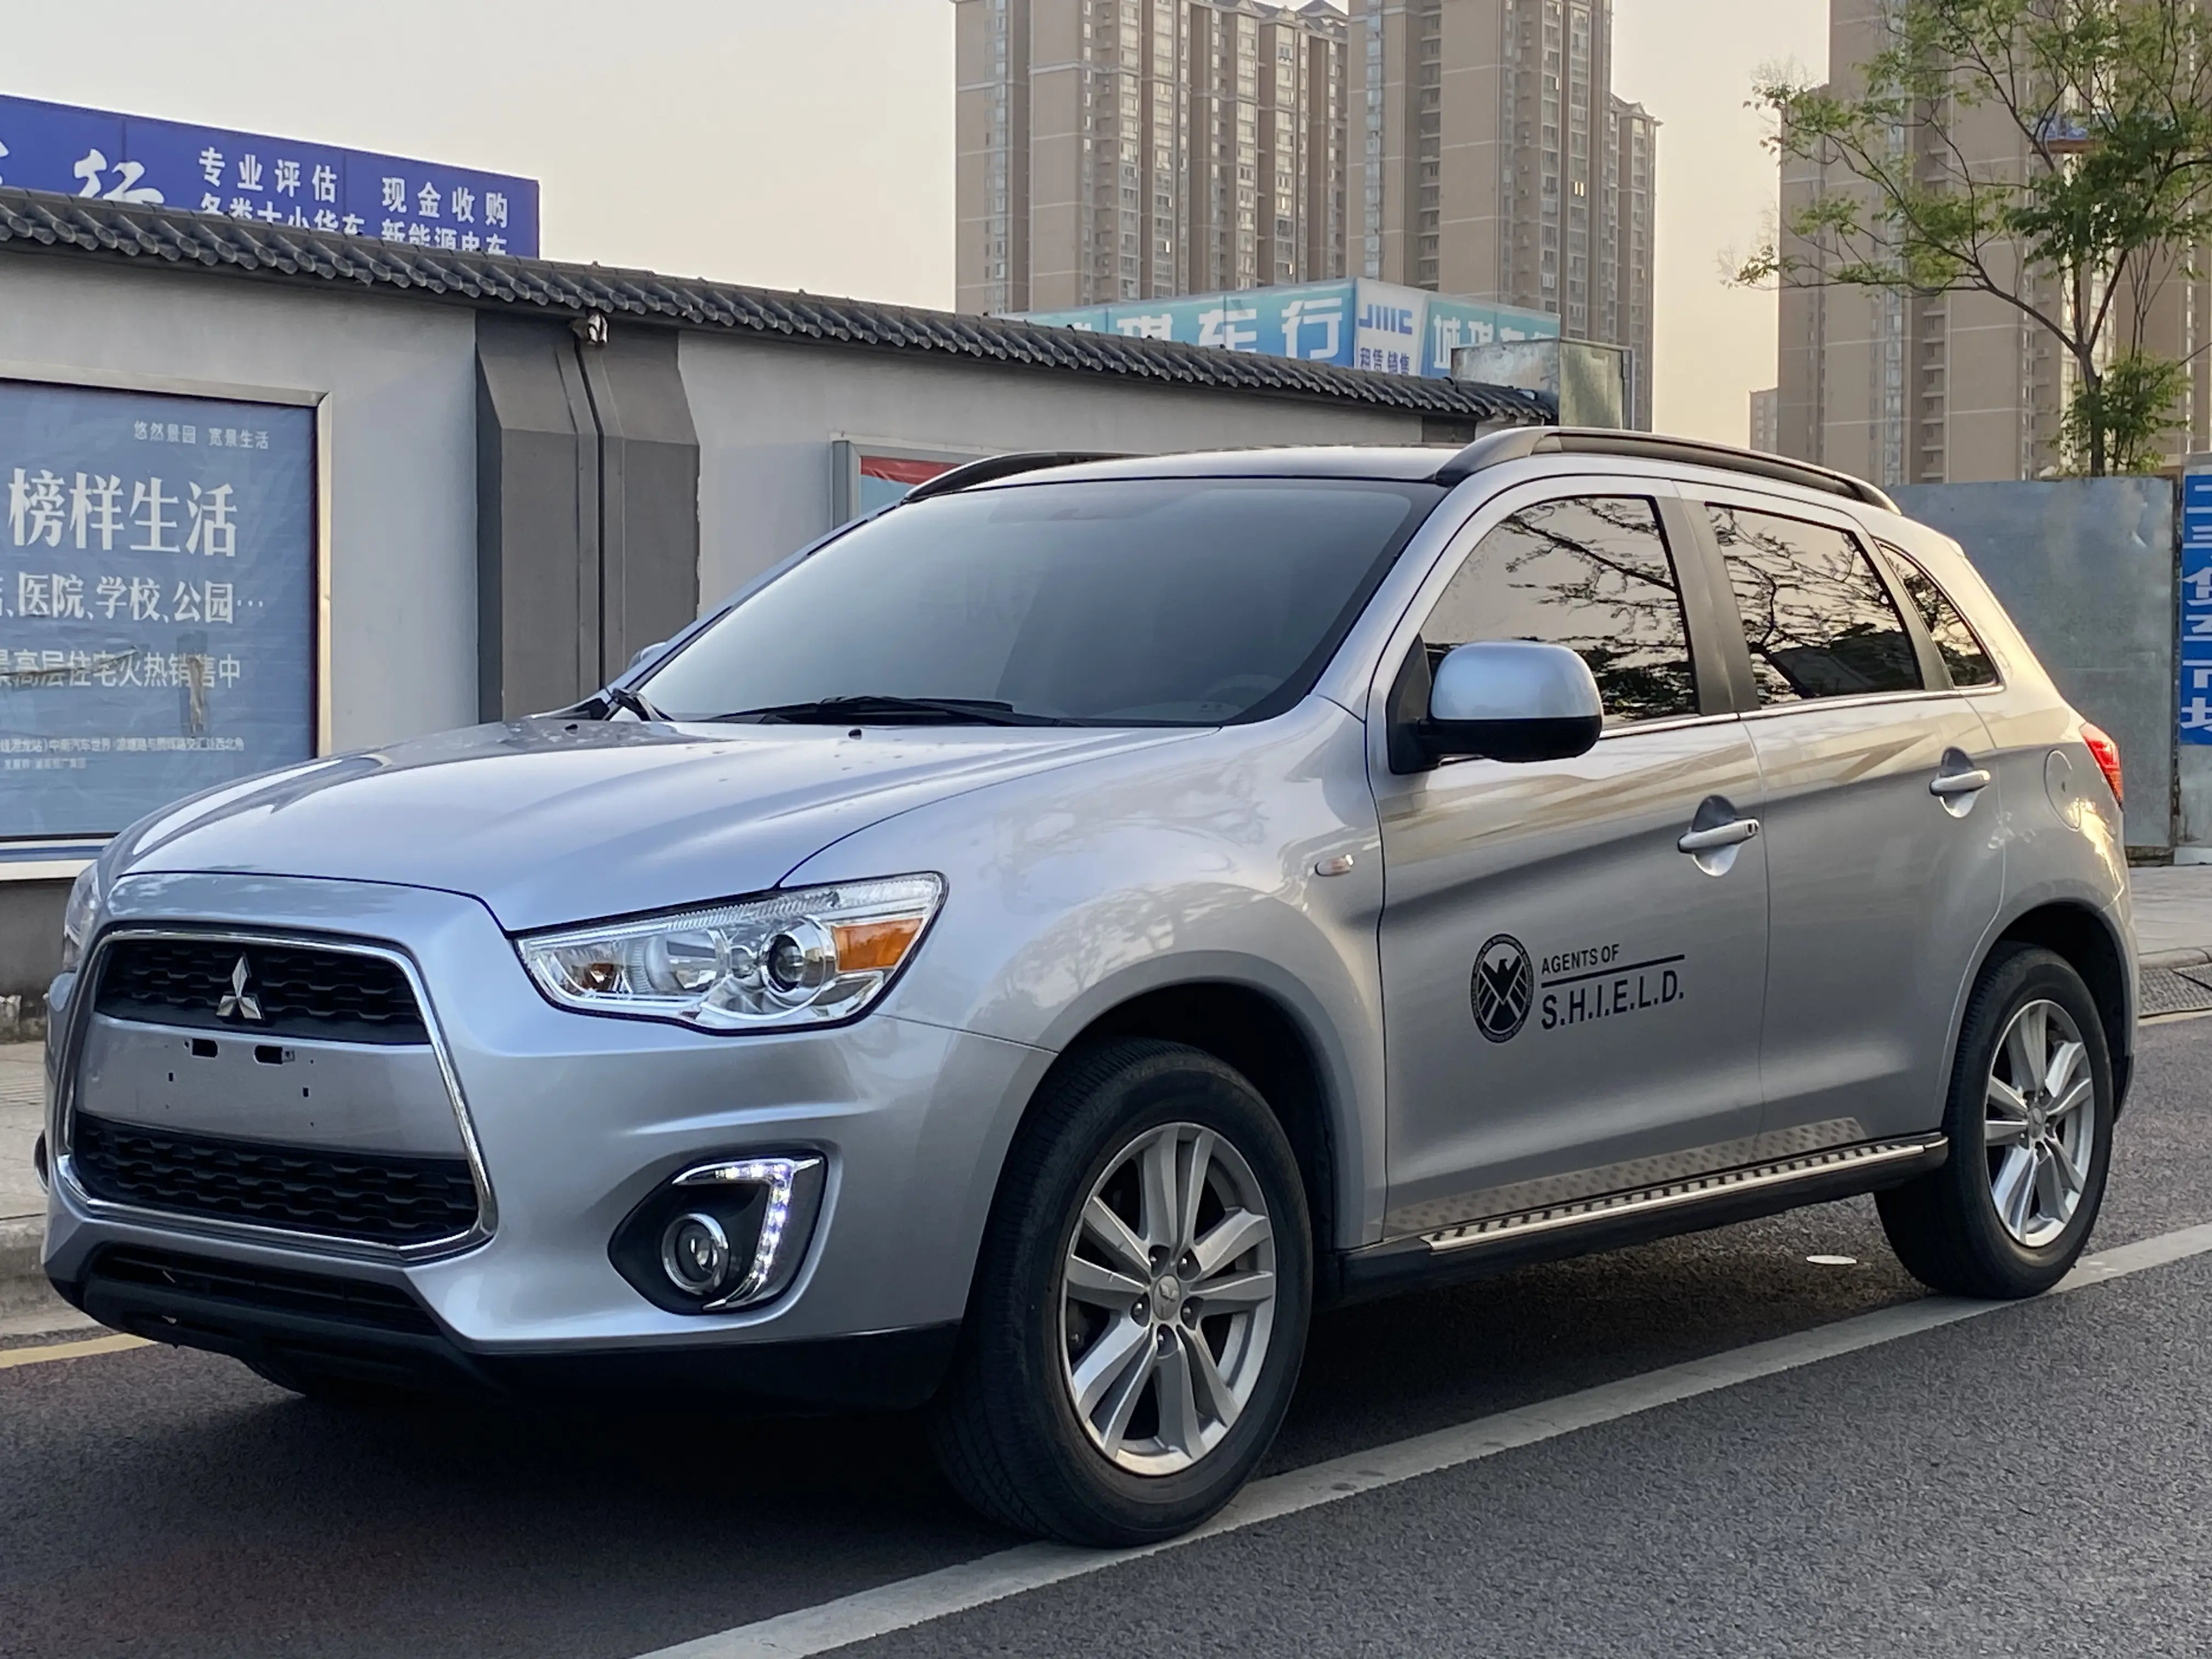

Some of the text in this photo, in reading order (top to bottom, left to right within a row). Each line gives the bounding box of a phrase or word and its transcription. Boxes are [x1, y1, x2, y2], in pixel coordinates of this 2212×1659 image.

[199, 147, 508, 228] 专业评估 现金收购
[8, 467, 238, 557] 榜样生活
[1542, 944, 1620, 975] AGENTS OF
[1541, 970, 1685, 1030] S.H.I.E.L.D.
